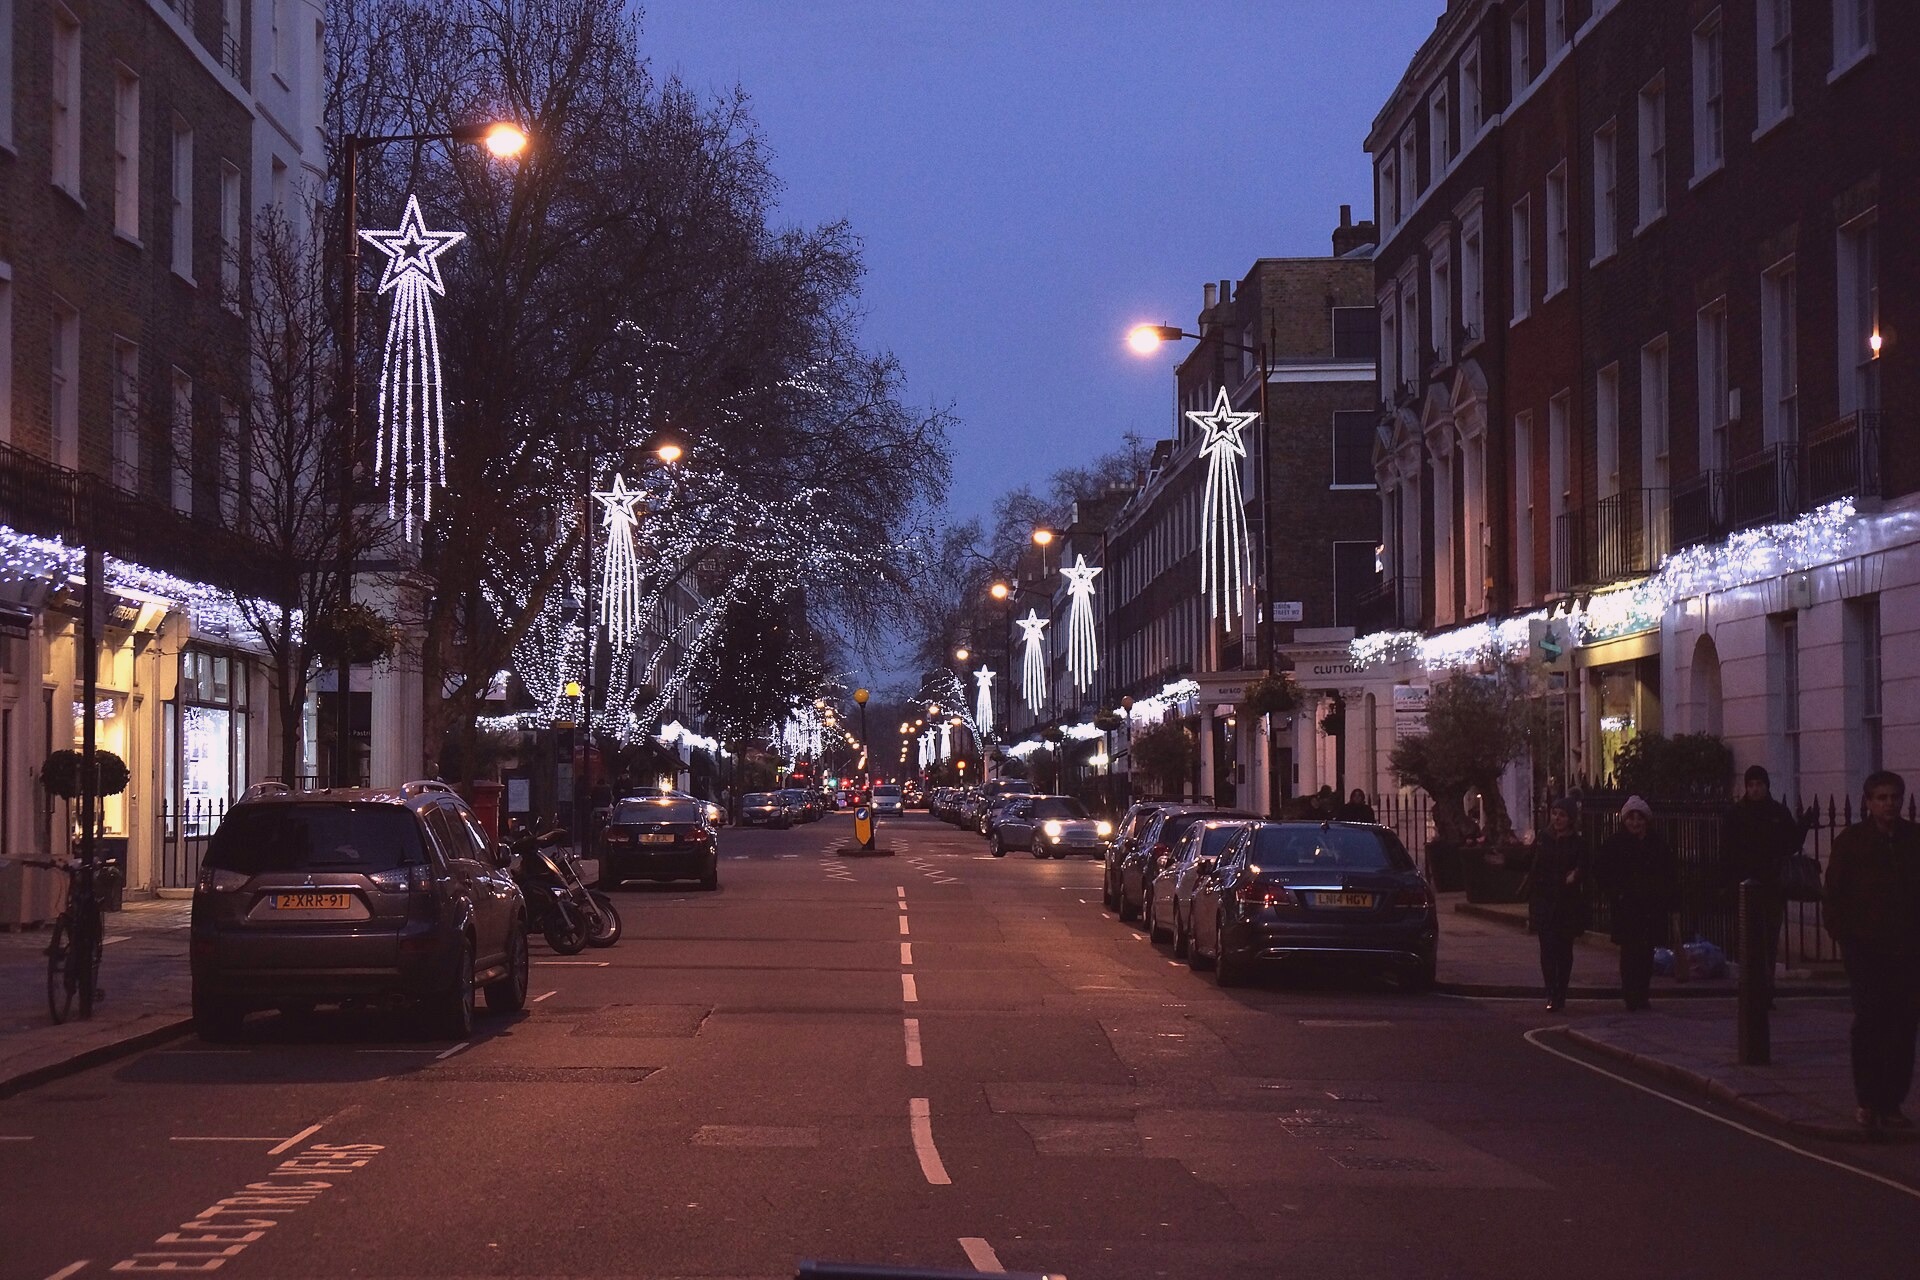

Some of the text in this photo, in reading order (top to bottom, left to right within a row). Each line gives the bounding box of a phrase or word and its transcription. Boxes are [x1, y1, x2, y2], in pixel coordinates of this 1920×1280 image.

[1313, 664, 1364, 675] CLUTTONS
[282, 894, 344, 907] 2-XRR-91
[1318, 893, 1368, 905] LN14 HGY
[110, 1143, 385, 1271] ELECTRIC VEHS
